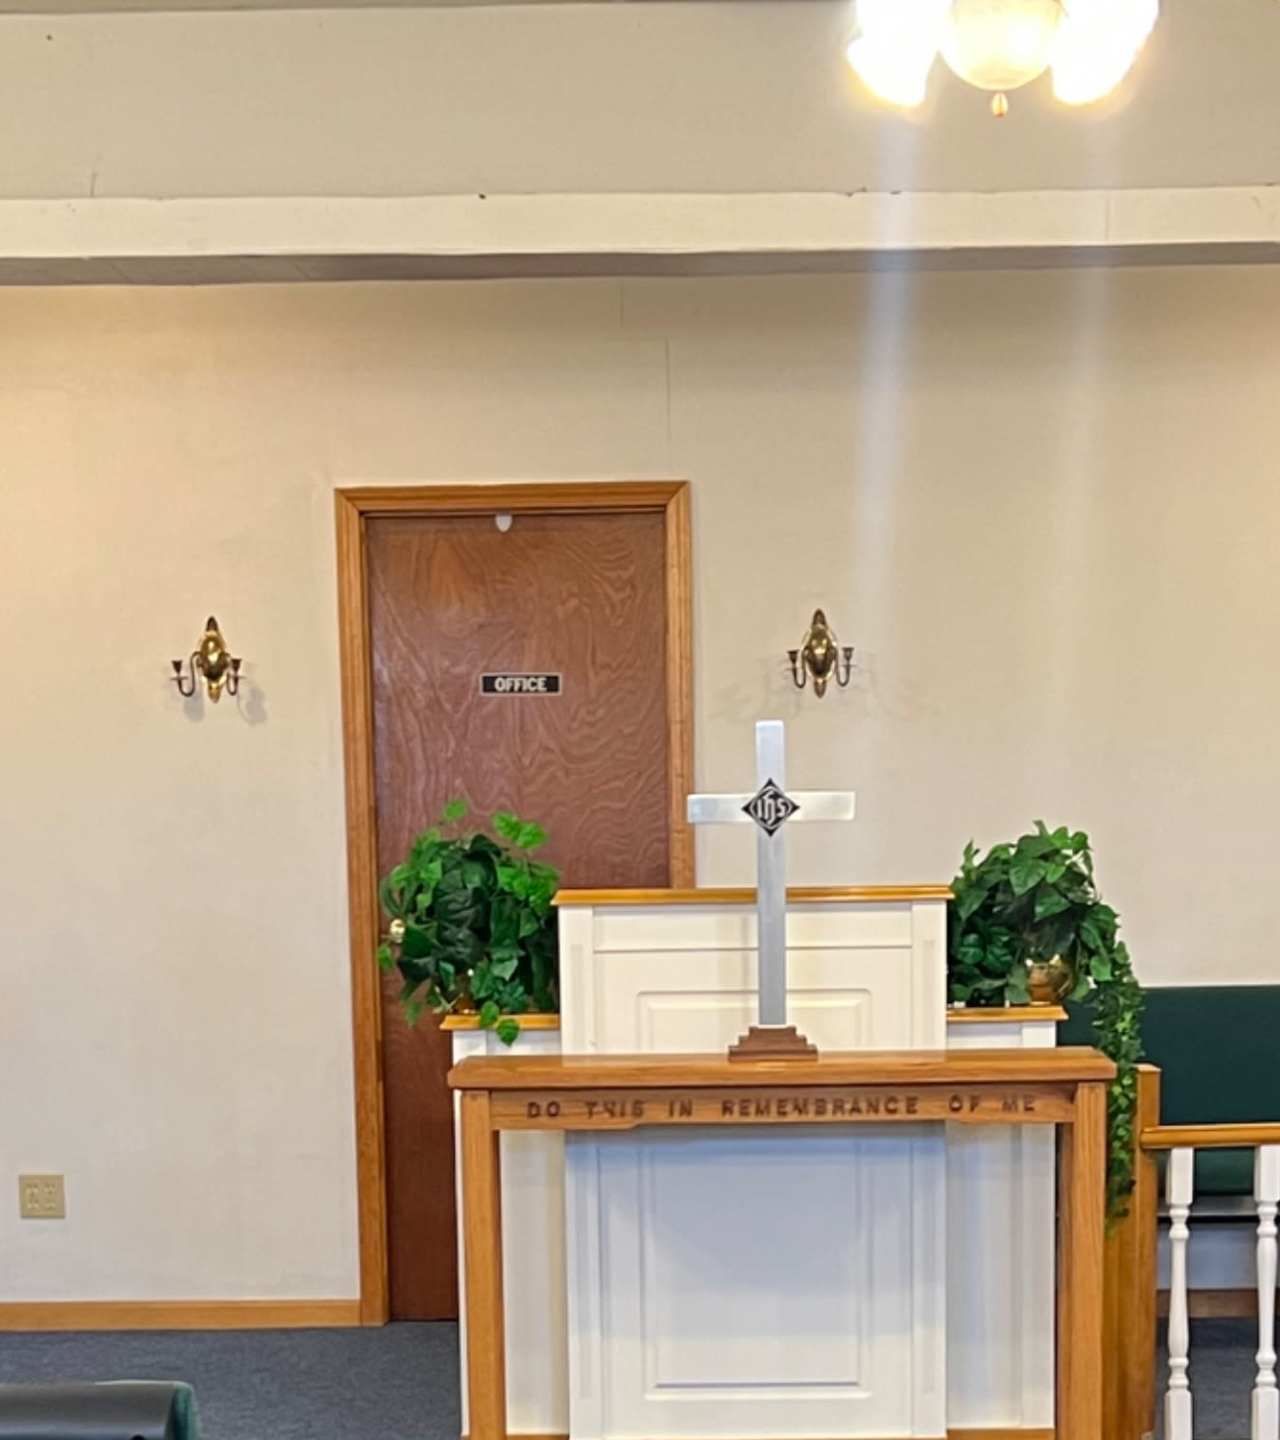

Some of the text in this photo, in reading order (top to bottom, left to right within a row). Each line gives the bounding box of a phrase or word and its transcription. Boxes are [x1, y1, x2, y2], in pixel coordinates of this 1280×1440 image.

[494, 677, 547, 691] OFFICE
[527, 1094, 1036, 1118] DO THIS IN REMEMBRANCE OF ME
